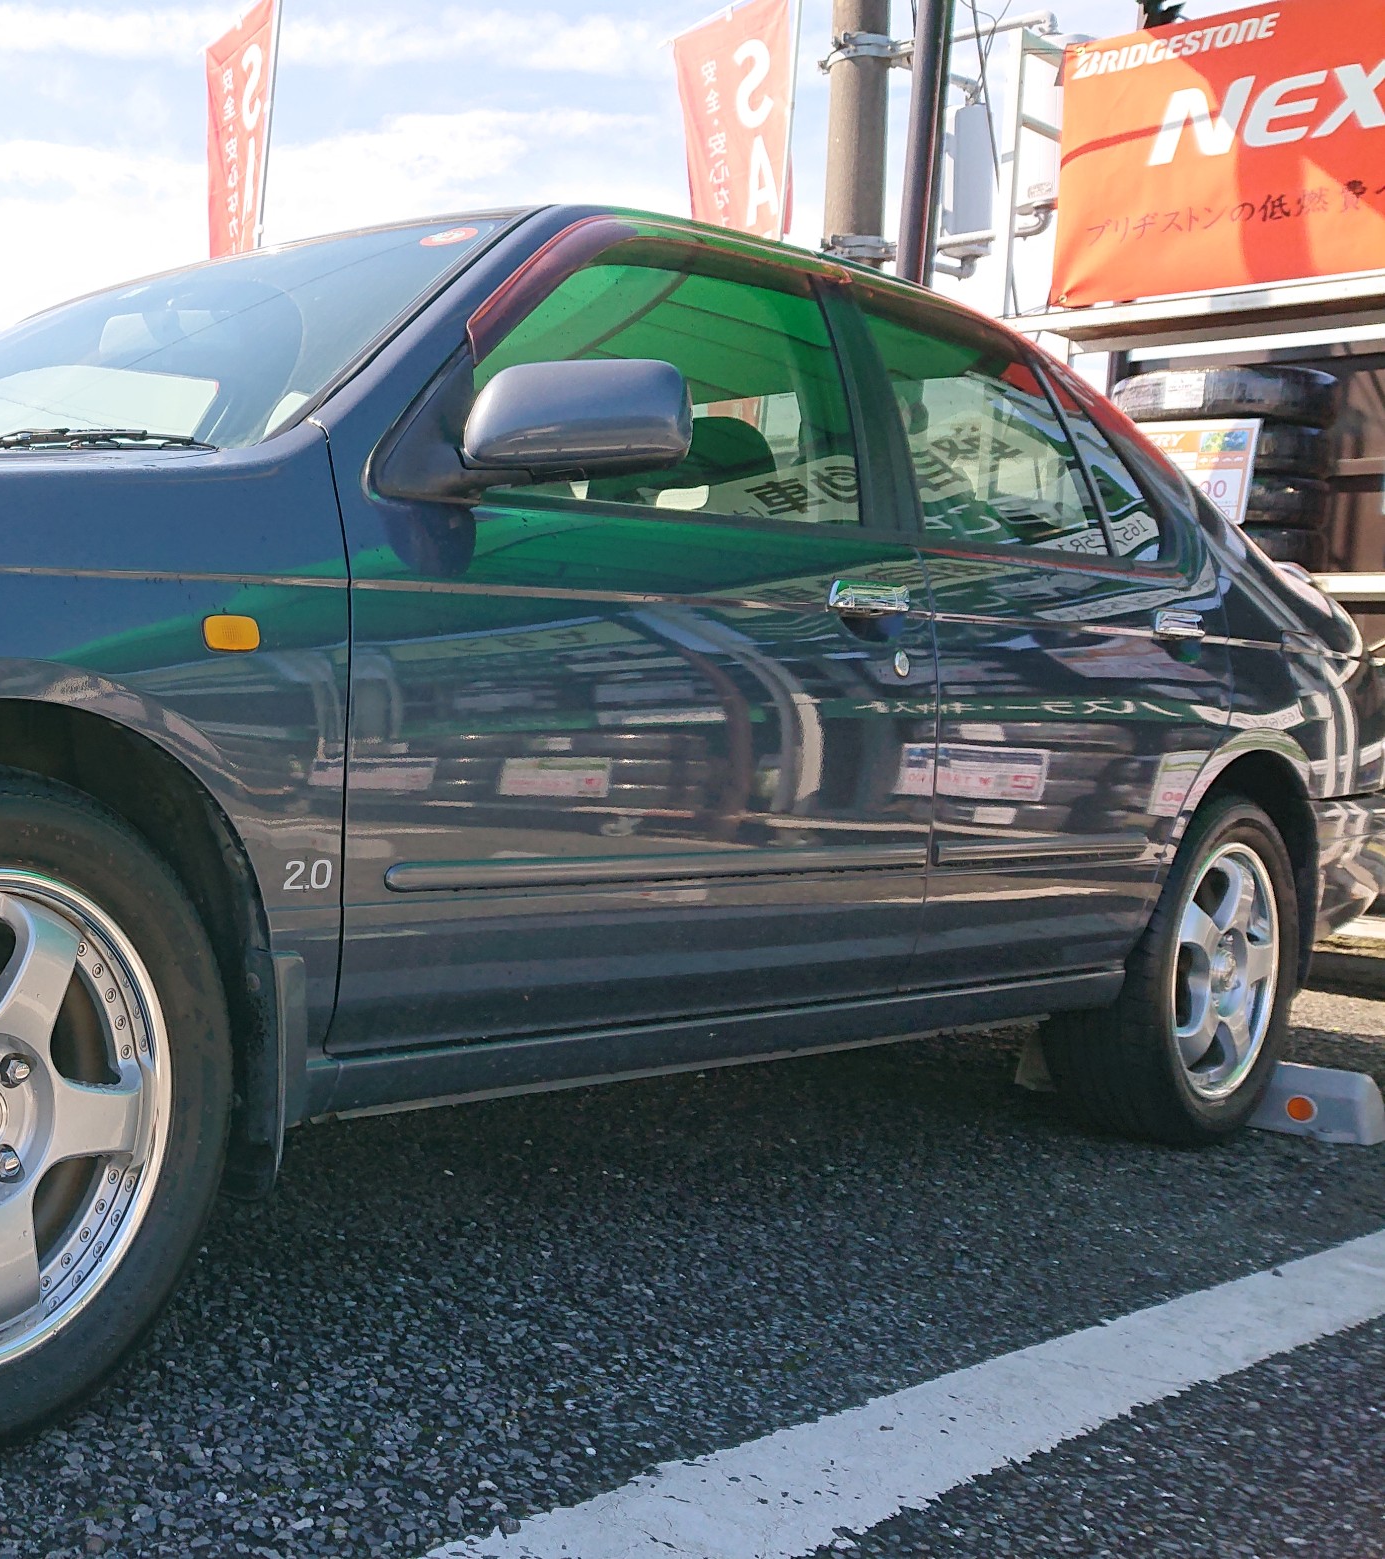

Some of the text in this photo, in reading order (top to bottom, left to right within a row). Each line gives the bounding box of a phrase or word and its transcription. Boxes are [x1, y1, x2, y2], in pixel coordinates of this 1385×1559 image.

[1071, 12, 1281, 80] BRIDGESTONE
[1146, 59, 1385, 167] NEX
[1086, 179, 1385, 247] ブリヂストンの低燃費
[283, 859, 333, 890] 2.0
